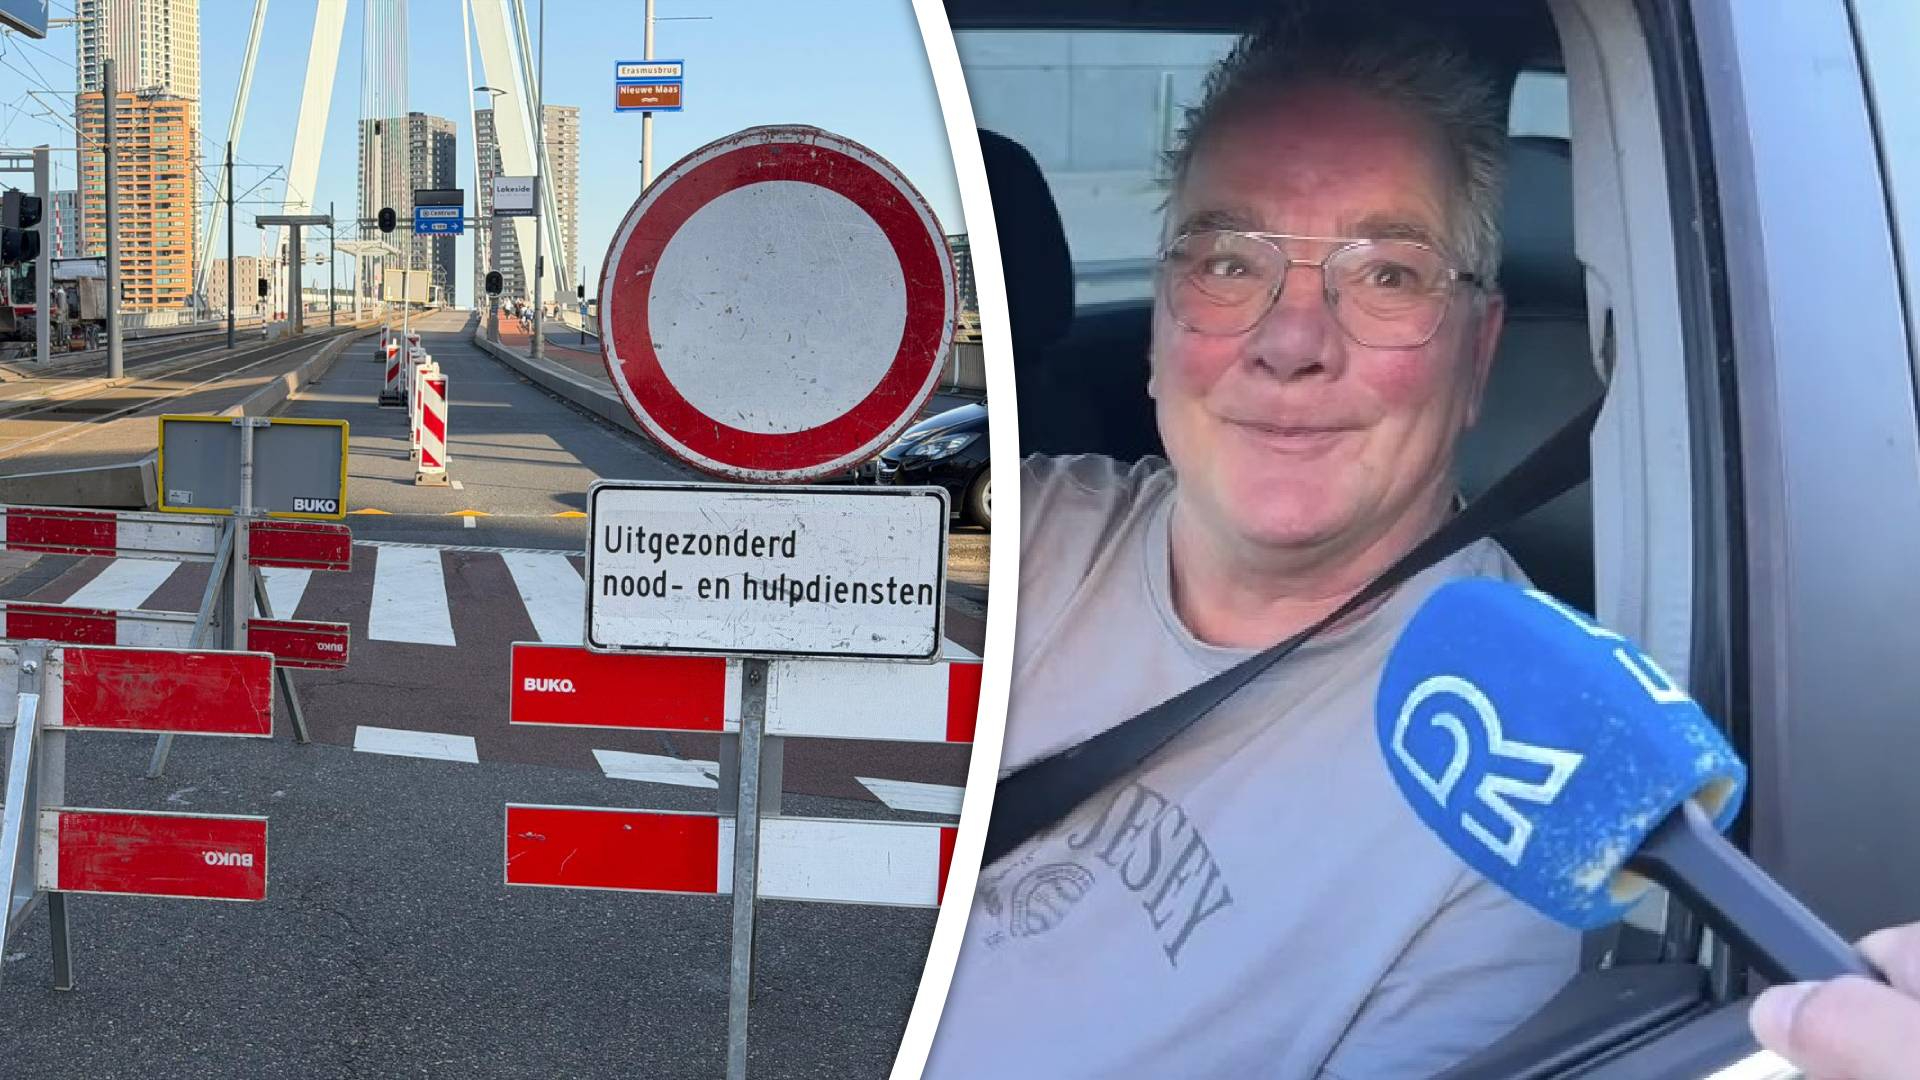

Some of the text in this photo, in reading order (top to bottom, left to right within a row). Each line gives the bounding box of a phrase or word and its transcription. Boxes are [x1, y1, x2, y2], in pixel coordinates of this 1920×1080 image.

[621, 66, 679, 75] Erasmusbrug
[620, 85, 678, 95] Nieuwe Maas
[294, 498, 336, 513] BUKO
[604, 525, 797, 564] Uitgezonderd
[602, 570, 934, 608] nood- en hulpdiensten
[524, 677, 577, 693] BUKO.
